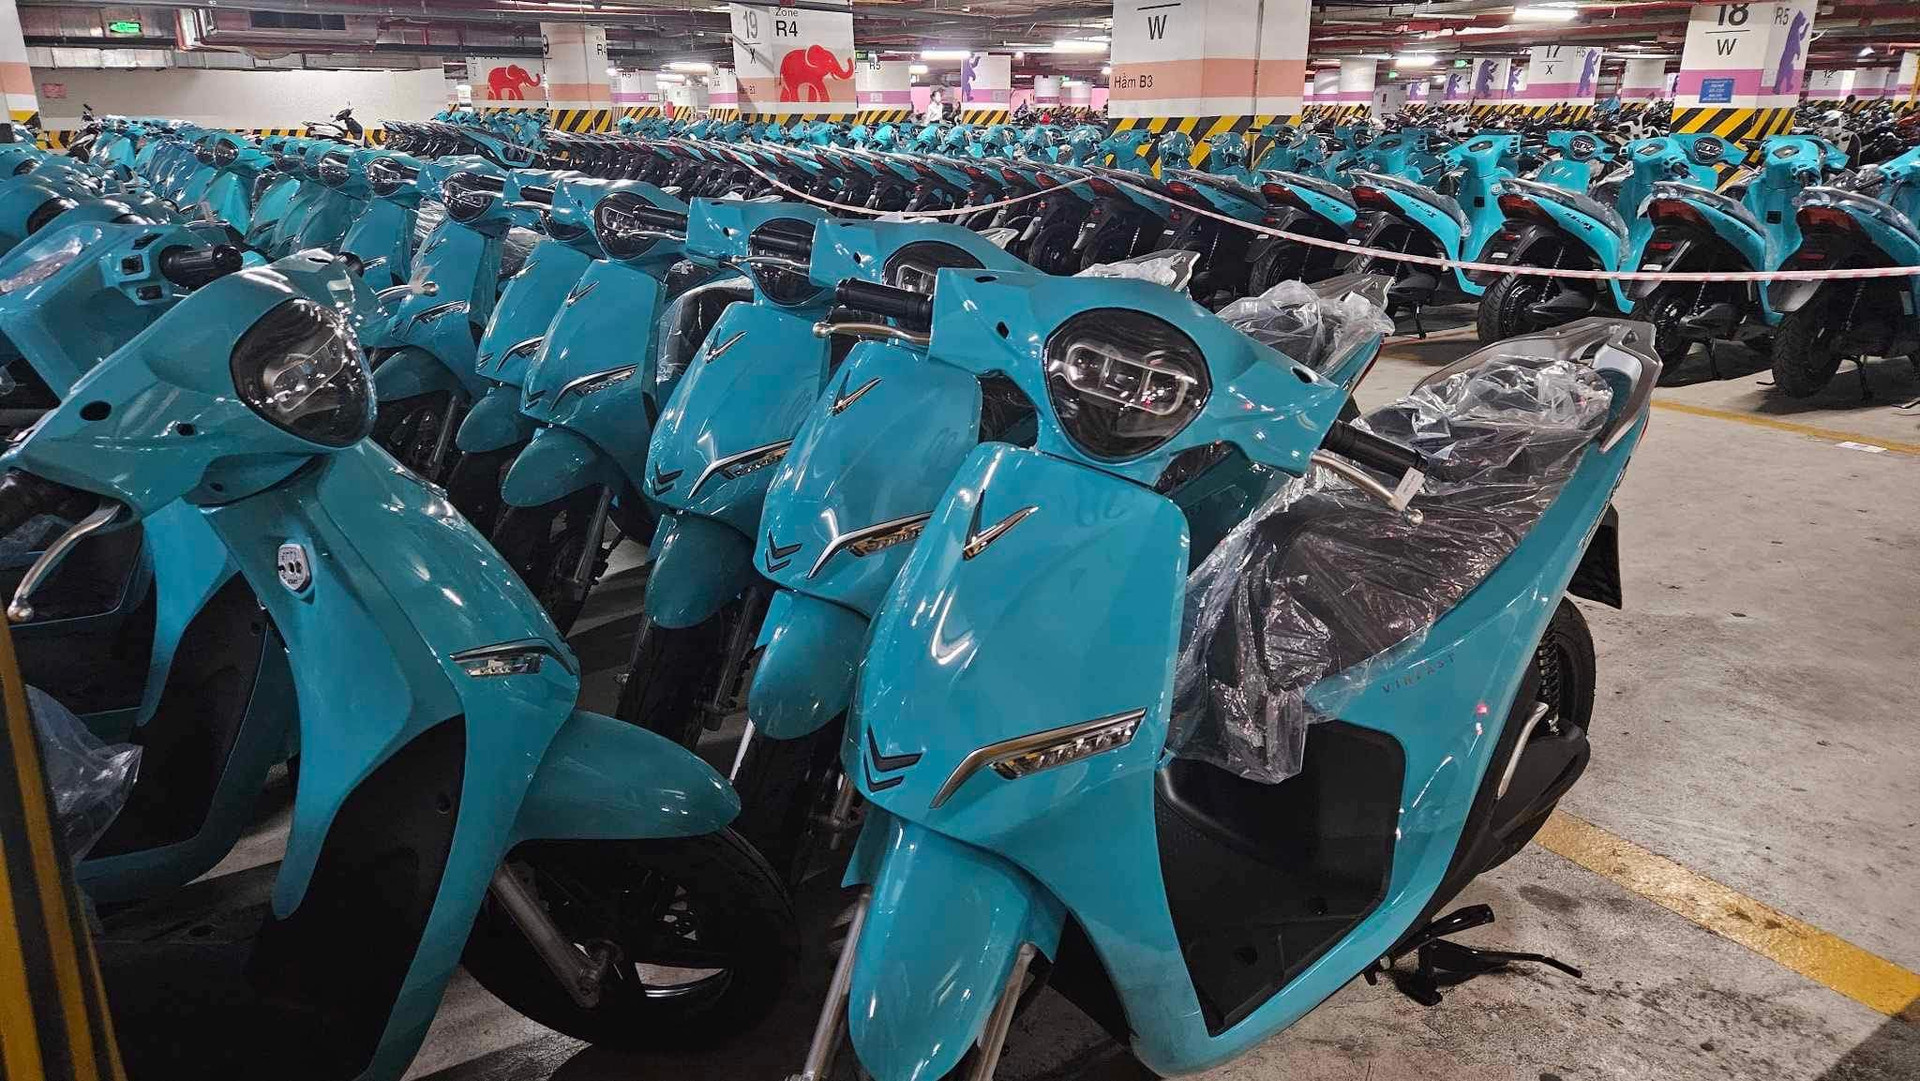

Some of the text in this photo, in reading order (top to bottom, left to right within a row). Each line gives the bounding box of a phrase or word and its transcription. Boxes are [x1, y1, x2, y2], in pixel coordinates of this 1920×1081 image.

[775, 7, 799, 17] Zone
[1717, 3, 1749, 26] 18
[1774, 7, 1790, 26] R5
[743, 11, 758, 39] 19
[775, 20, 799, 37] R4
[1148, 15, 1167, 40] W
[1545, 45, 1561, 58] 17
[1717, 38, 1737, 56] W
[750, 48, 757, 64] X
[1545, 65, 1554, 75] X
[1114, 73, 1153, 89] Hầm B3
